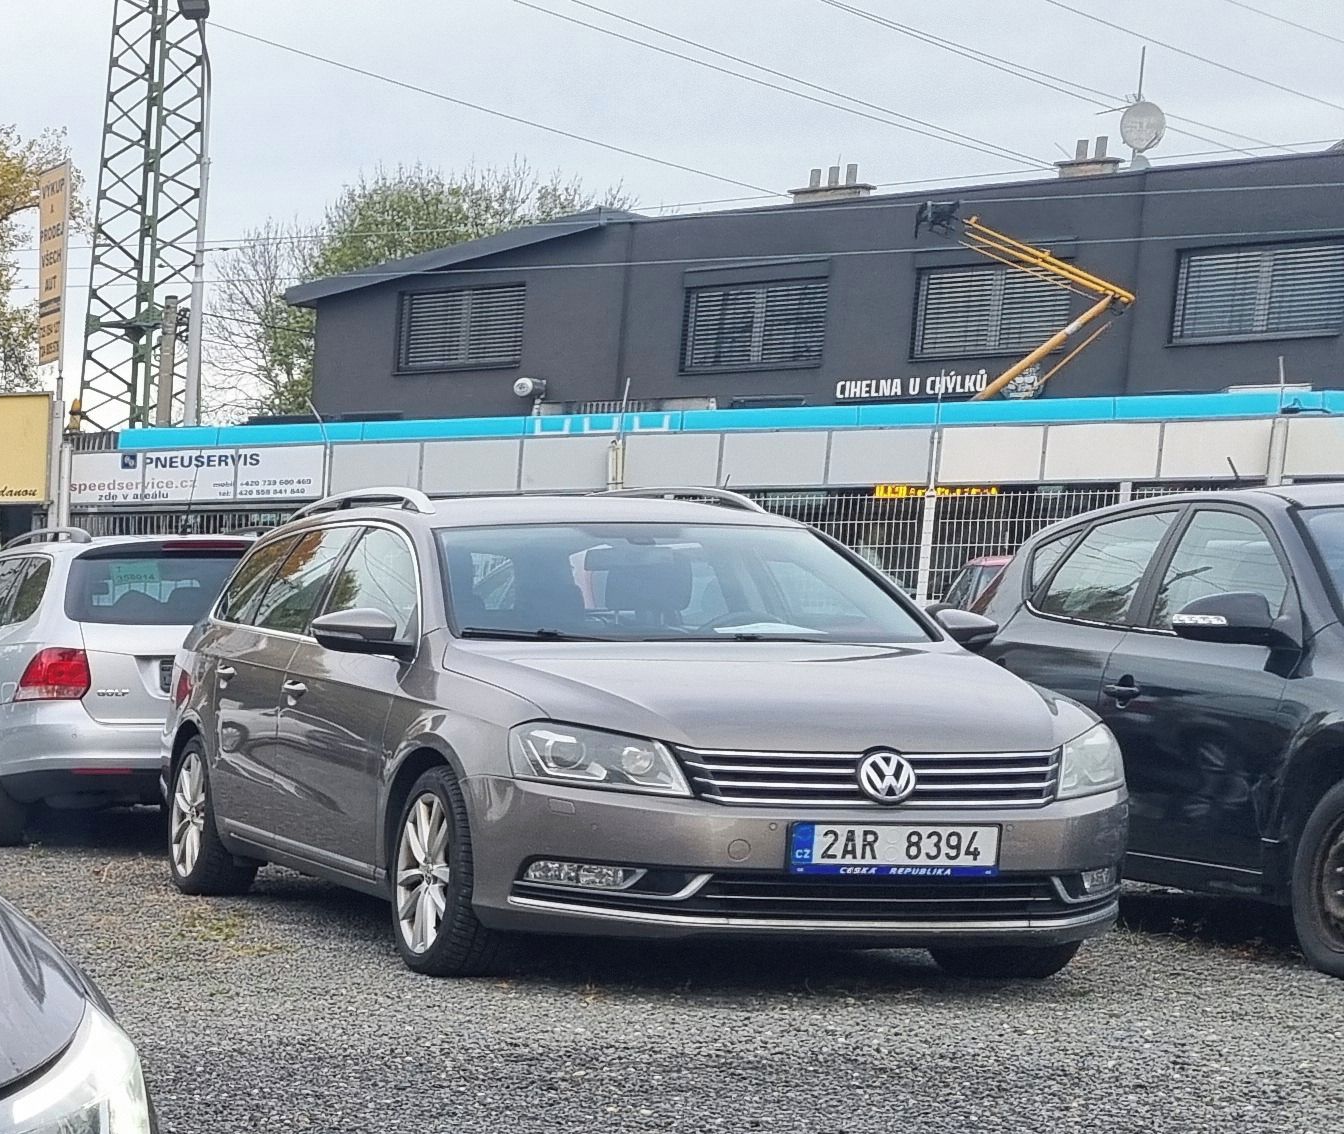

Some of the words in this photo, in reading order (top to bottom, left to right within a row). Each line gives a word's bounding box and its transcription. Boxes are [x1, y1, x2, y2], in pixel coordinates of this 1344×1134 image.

[835, 378, 902, 399] CIHELNA
[908, 377, 921, 396] U
[925, 368, 988, 395] CHÝLKŮ
[144, 453, 260, 469] PNEUSERVIS
[69, 478, 197, 494] speedservice.cz
[97, 688, 130, 697] GOLF
[795, 850, 811, 859] CZ
[820, 829, 879, 860] 2AR
[905, 830, 981, 861] 8394
[889, 866, 952, 875] REPUBLIKA
